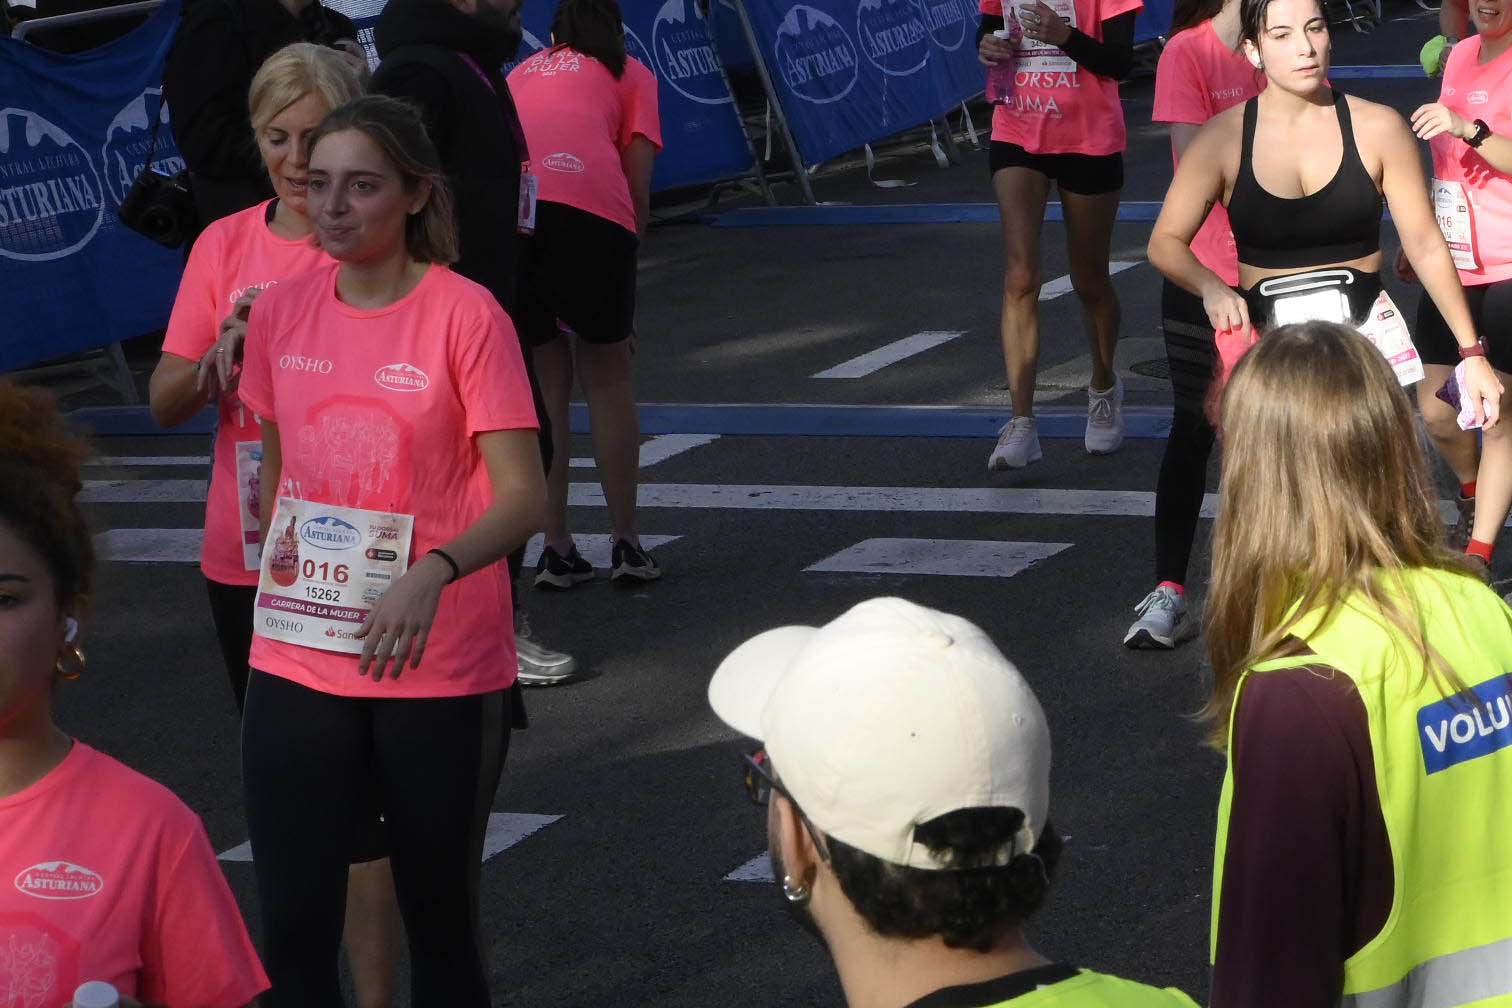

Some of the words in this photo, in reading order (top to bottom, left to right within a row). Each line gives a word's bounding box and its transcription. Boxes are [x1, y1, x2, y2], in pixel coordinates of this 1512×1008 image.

[524, 63, 580, 75] MUJER
[560, 55, 579, 65] LA
[1014, 72, 1081, 88] ORSAL
[1015, 96, 1060, 113] UMA
[0, 173, 100, 227] STURIANA
[279, 354, 333, 375] OYSHO
[378, 371, 425, 389] ASTURIANA
[304, 526, 356, 545] ASTURIANA
[302, 559, 349, 584] 016
[306, 586, 341, 602] 15262
[271, 599, 305, 611] CARRERA
[306, 606, 316, 614] DE
[317, 606, 328, 615] LA
[330, 609, 360, 620] MUJER
[265, 616, 304, 634] OYSHO
[22, 874, 97, 891] ASTURIANA
